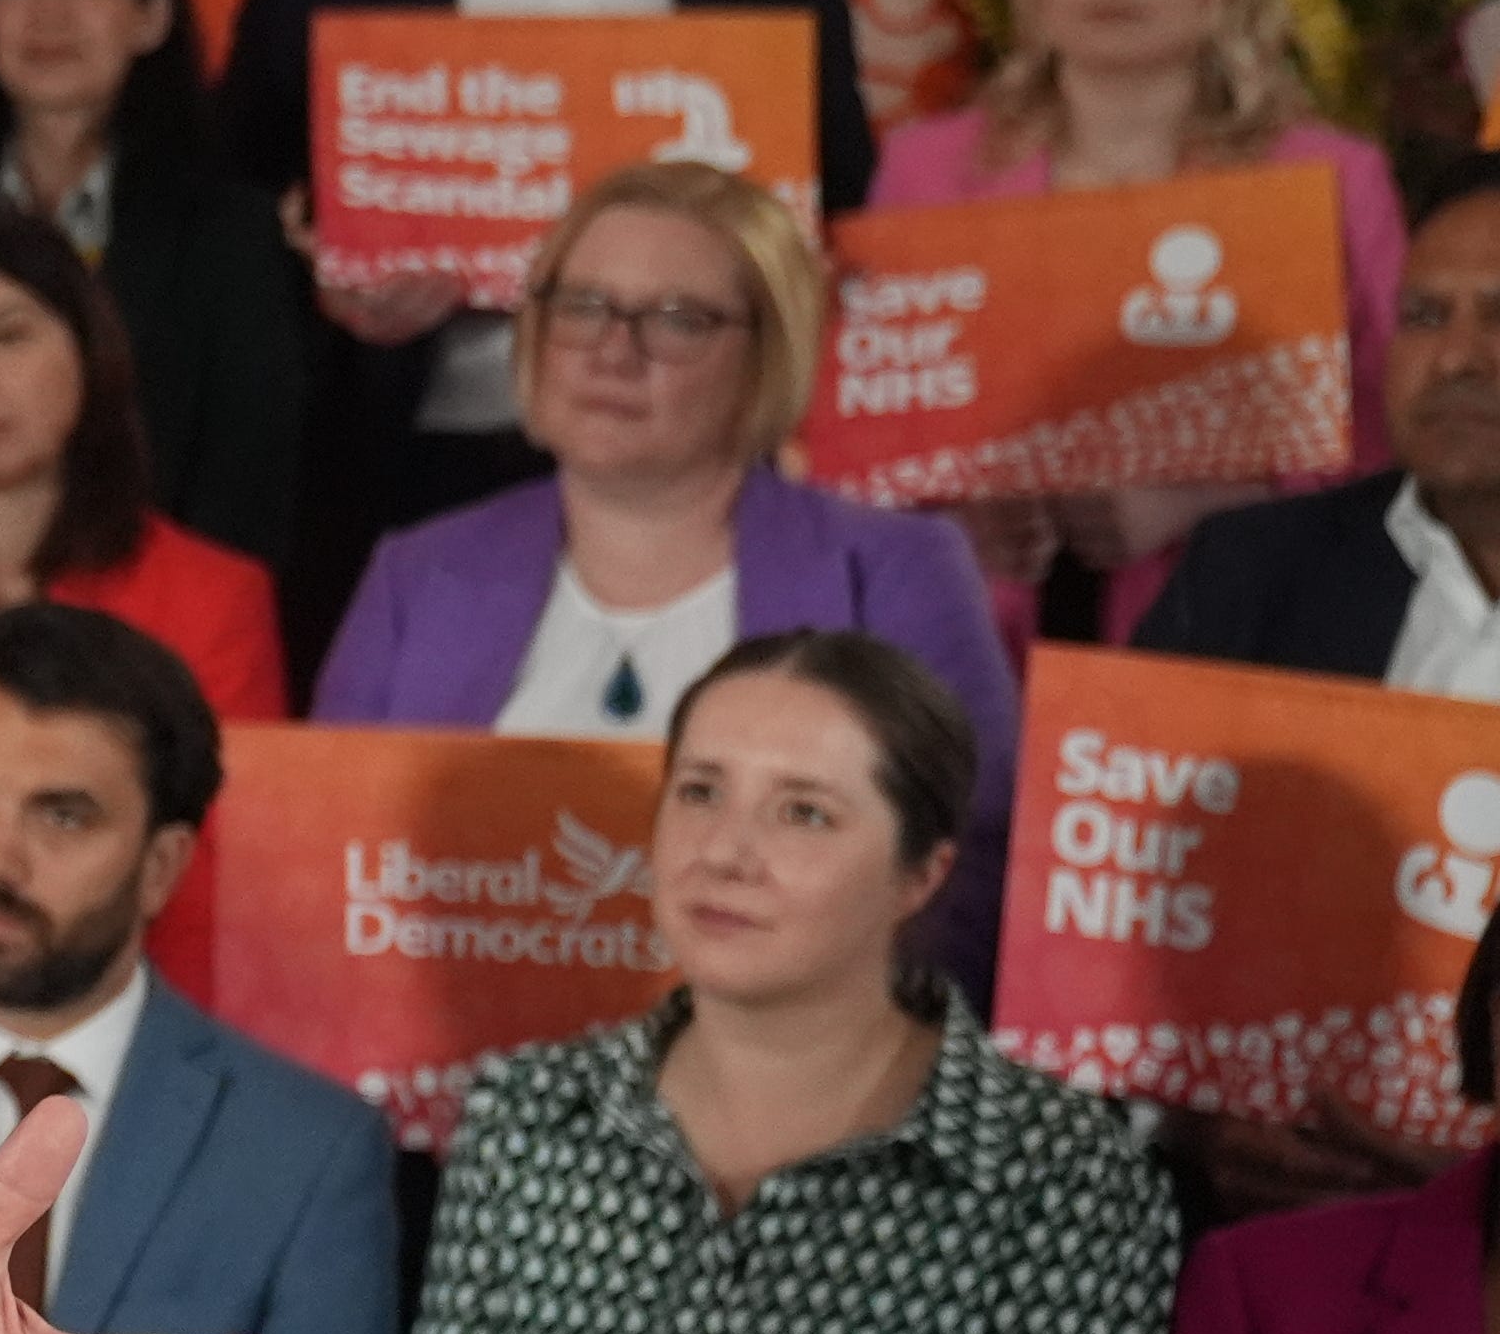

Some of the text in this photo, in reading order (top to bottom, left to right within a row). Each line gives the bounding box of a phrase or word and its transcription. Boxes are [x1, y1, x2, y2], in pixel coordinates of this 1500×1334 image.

[339, 63, 561, 116] End the
[339, 116, 571, 173] Sewage
[339, 162, 571, 220] Scandal
[1056, 727, 1241, 815] Save
[344, 838, 541, 906] Liberal
[1051, 799, 1202, 877] Our
[344, 900, 672, 972] Democrats
[1044, 871, 1214, 951] NHS
